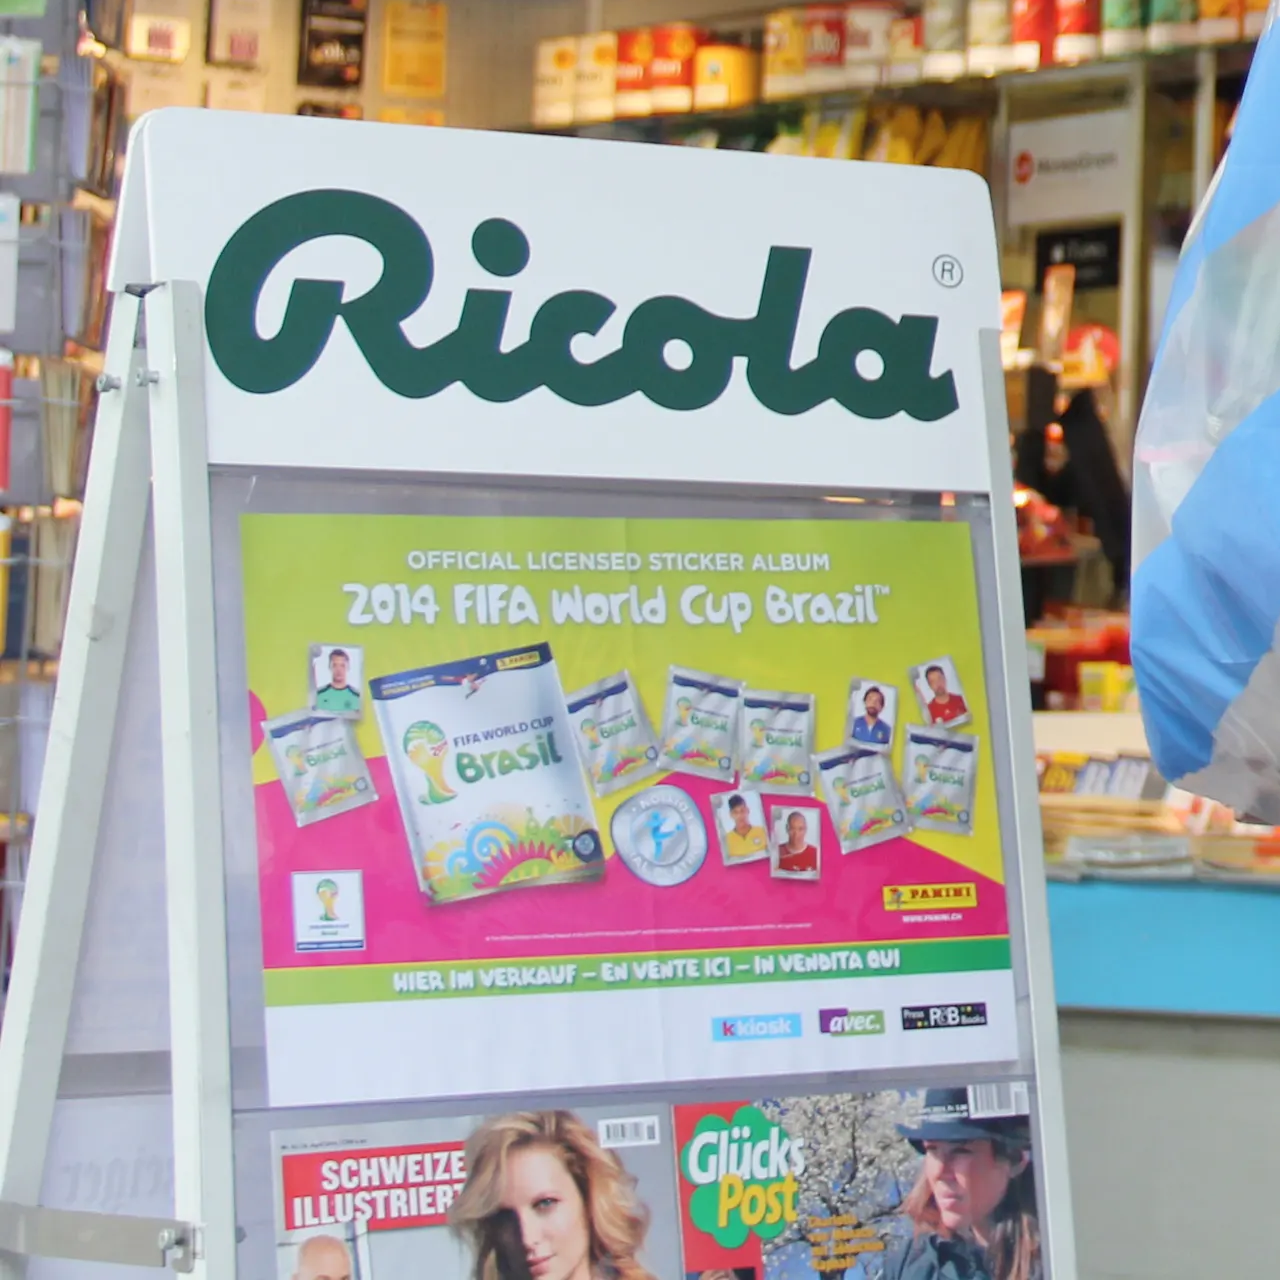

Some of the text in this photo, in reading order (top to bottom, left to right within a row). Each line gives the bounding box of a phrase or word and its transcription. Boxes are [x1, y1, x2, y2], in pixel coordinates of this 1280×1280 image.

[205, 187, 959, 423] Ricola
[406, 549, 830, 573] OFFICIAL LICENSED STICKER ALBUM
[342, 582, 441, 625] 2014
[453, 583, 540, 625] FIFA
[550, 584, 668, 625] World
[679, 584, 753, 634] Cup
[452, 716, 555, 749] FIFA WORLD CUP
[454, 731, 563, 784] Brasil
[910, 886, 972, 900] PANINI
[393, 947, 901, 993] HIER IM VERKAUF EN VENTE ICI IN VENDITA QUI
[320, 1150, 468, 1192] SCHWEIZE
[687, 1125, 806, 1185] Glücks
[718, 1171, 800, 1228] Post
